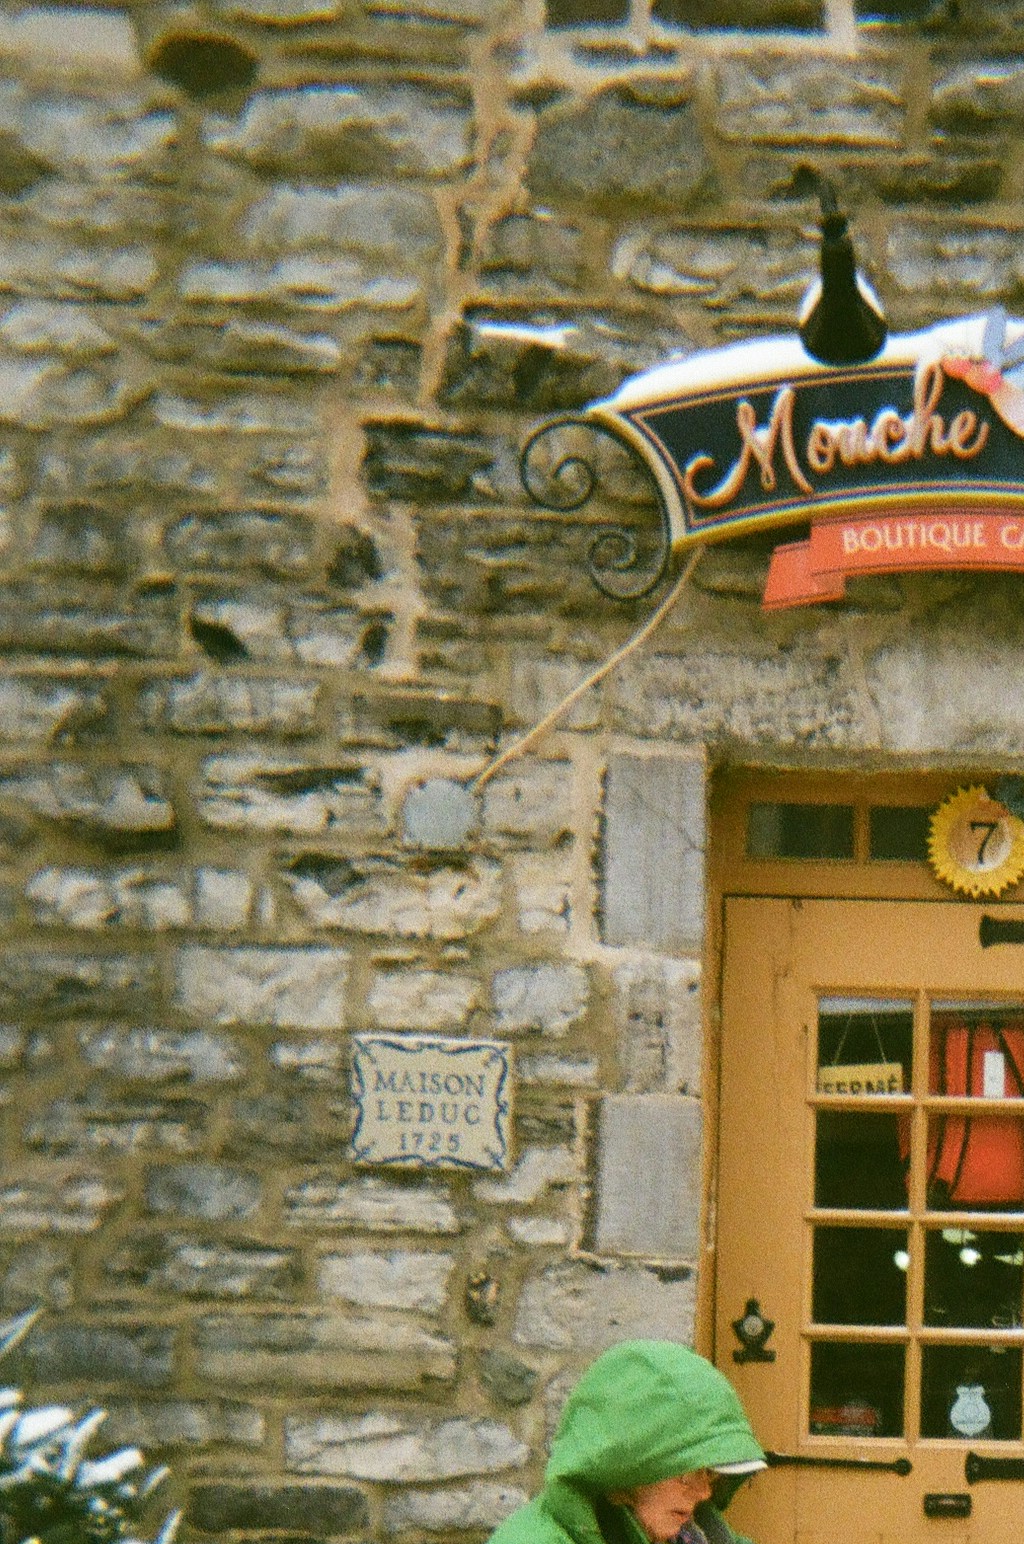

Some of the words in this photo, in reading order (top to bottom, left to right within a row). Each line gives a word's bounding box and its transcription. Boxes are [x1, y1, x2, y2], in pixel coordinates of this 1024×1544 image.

[684, 360, 990, 508] Mouche
[842, 521, 986, 555] BOUTIQUE
[970, 821, 999, 865] 7
[374, 1070, 486, 1097] MAISON
